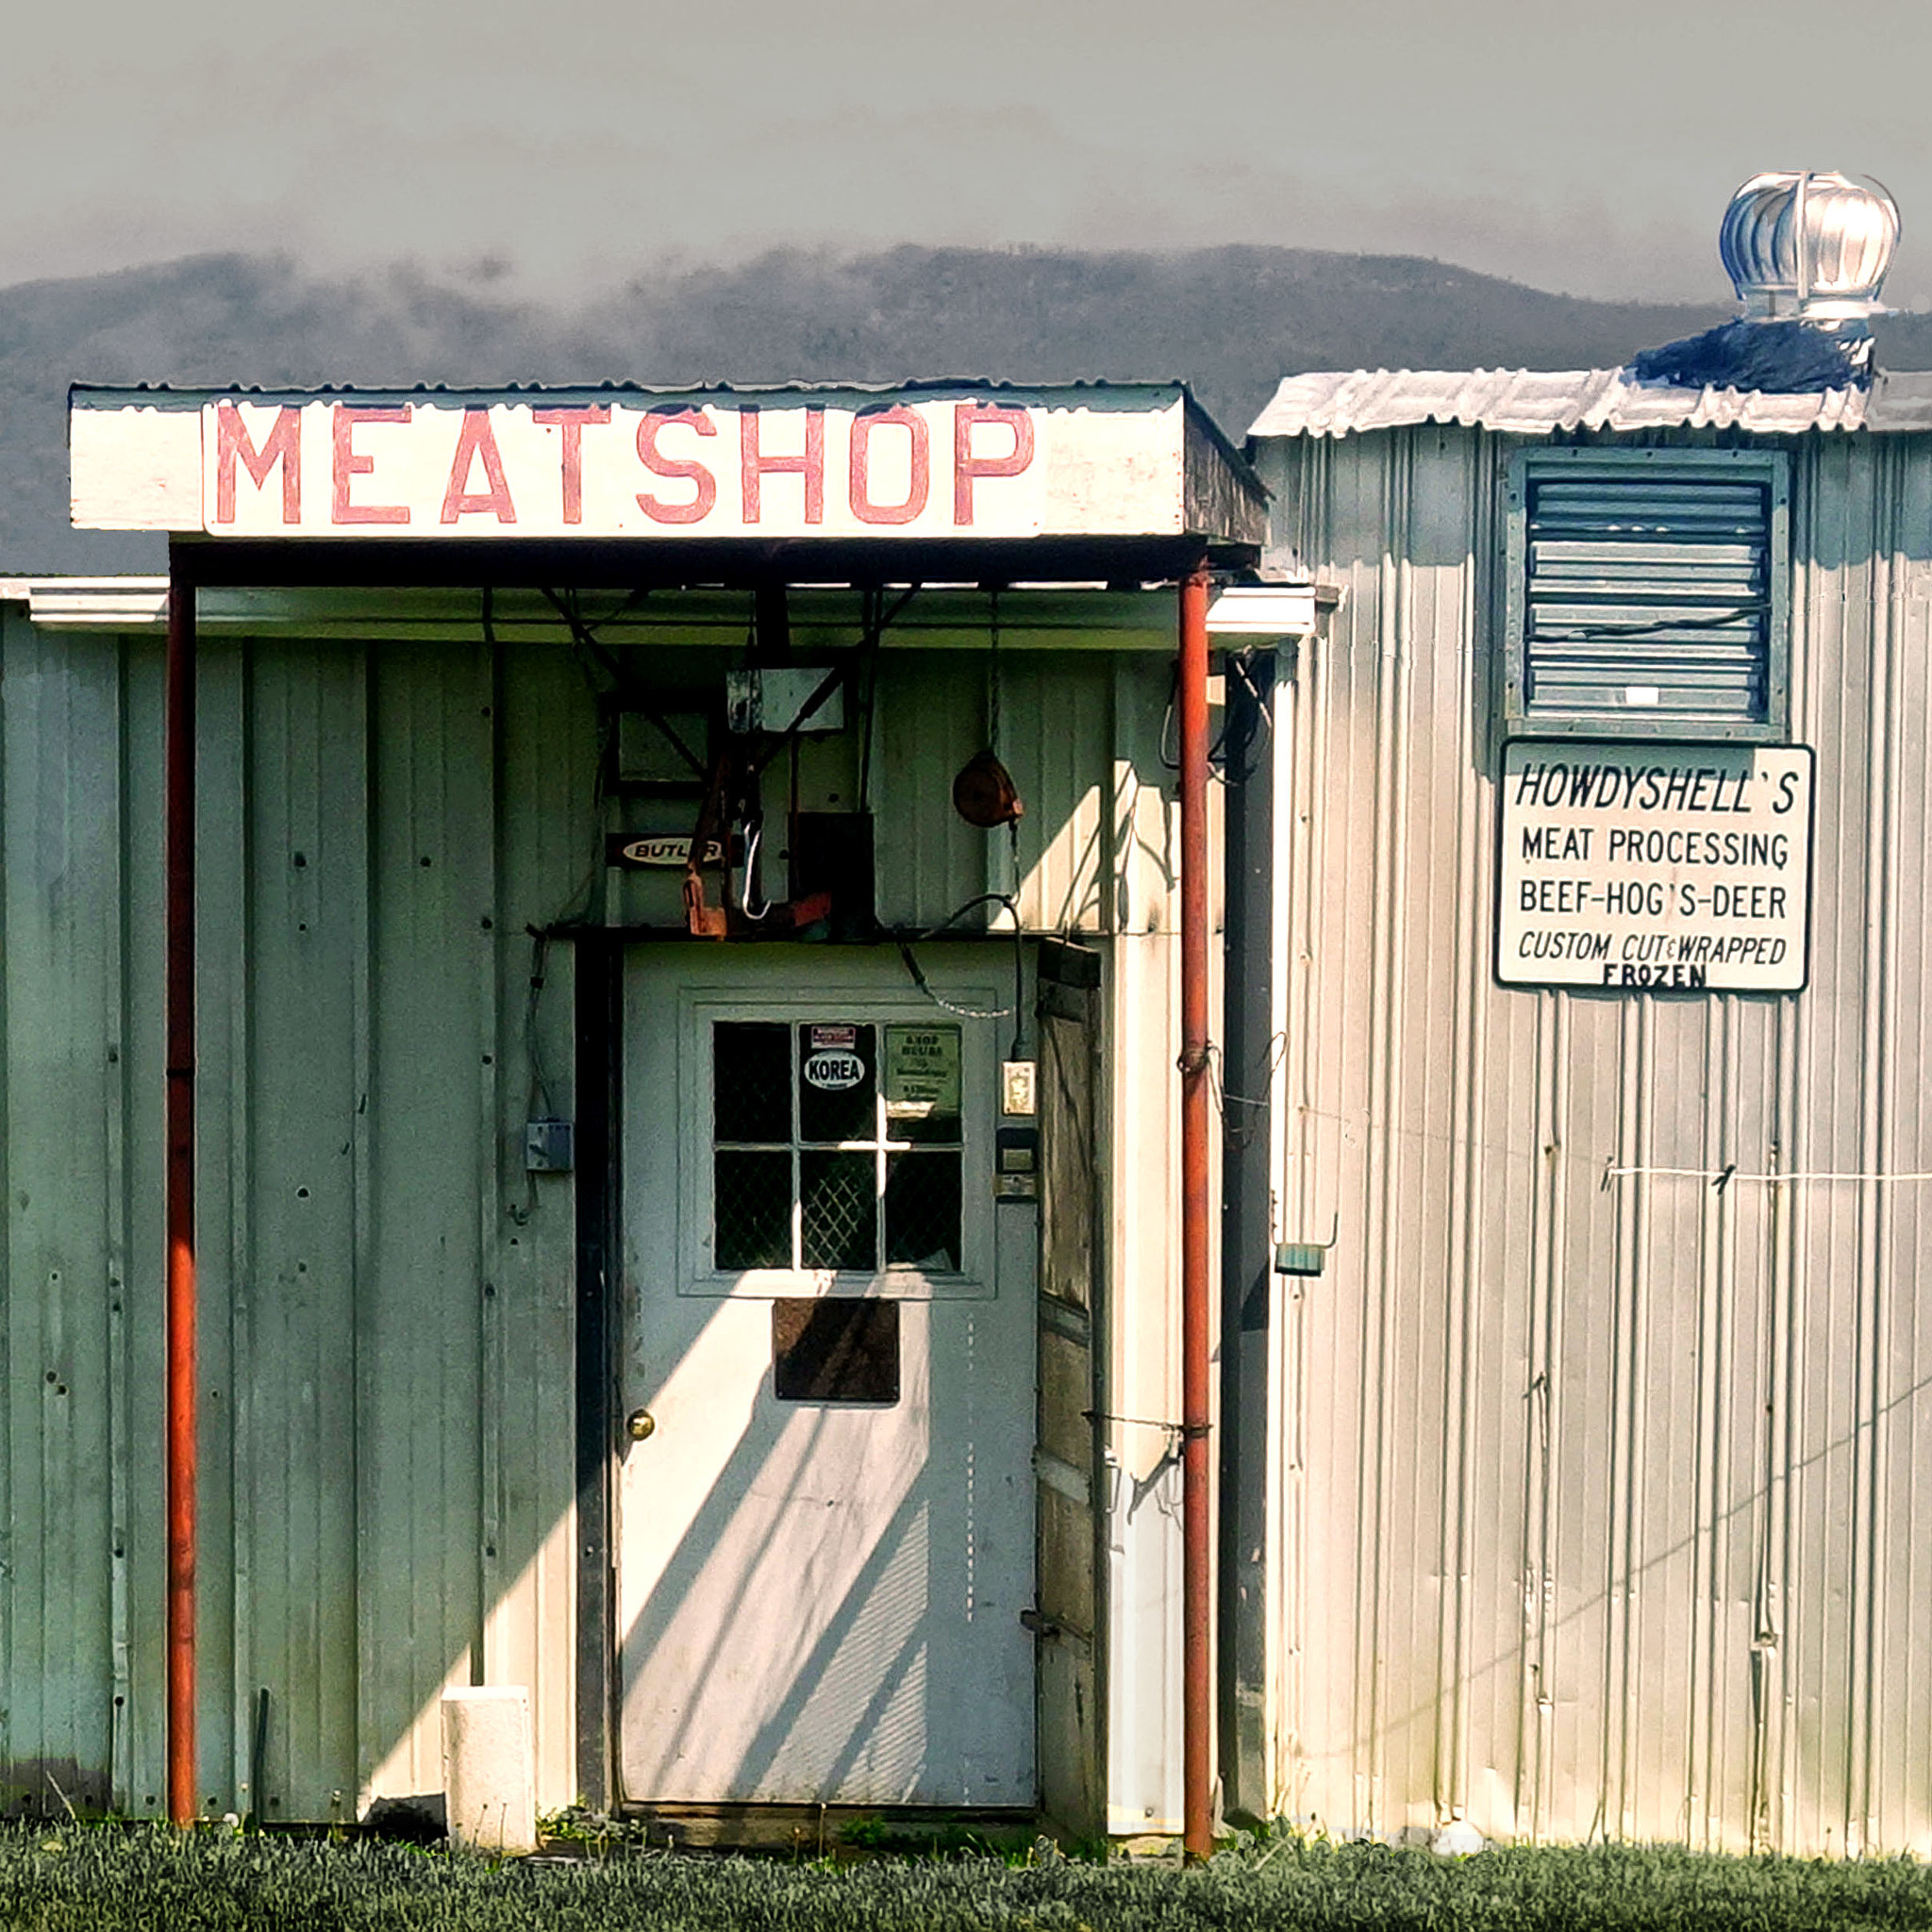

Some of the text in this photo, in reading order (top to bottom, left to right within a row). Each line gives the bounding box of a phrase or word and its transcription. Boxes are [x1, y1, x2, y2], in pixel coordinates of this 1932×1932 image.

[1515, 762, 1799, 813] HOWDYSHELL'S
[635, 843, 717, 858] BUTLR
[1522, 825, 1789, 869] MEAT PROCESSING
[1519, 930, 1612, 960] CUSTOM
[1603, 963, 1707, 988] FROZEN
[808, 1059, 860, 1080] KOREA
